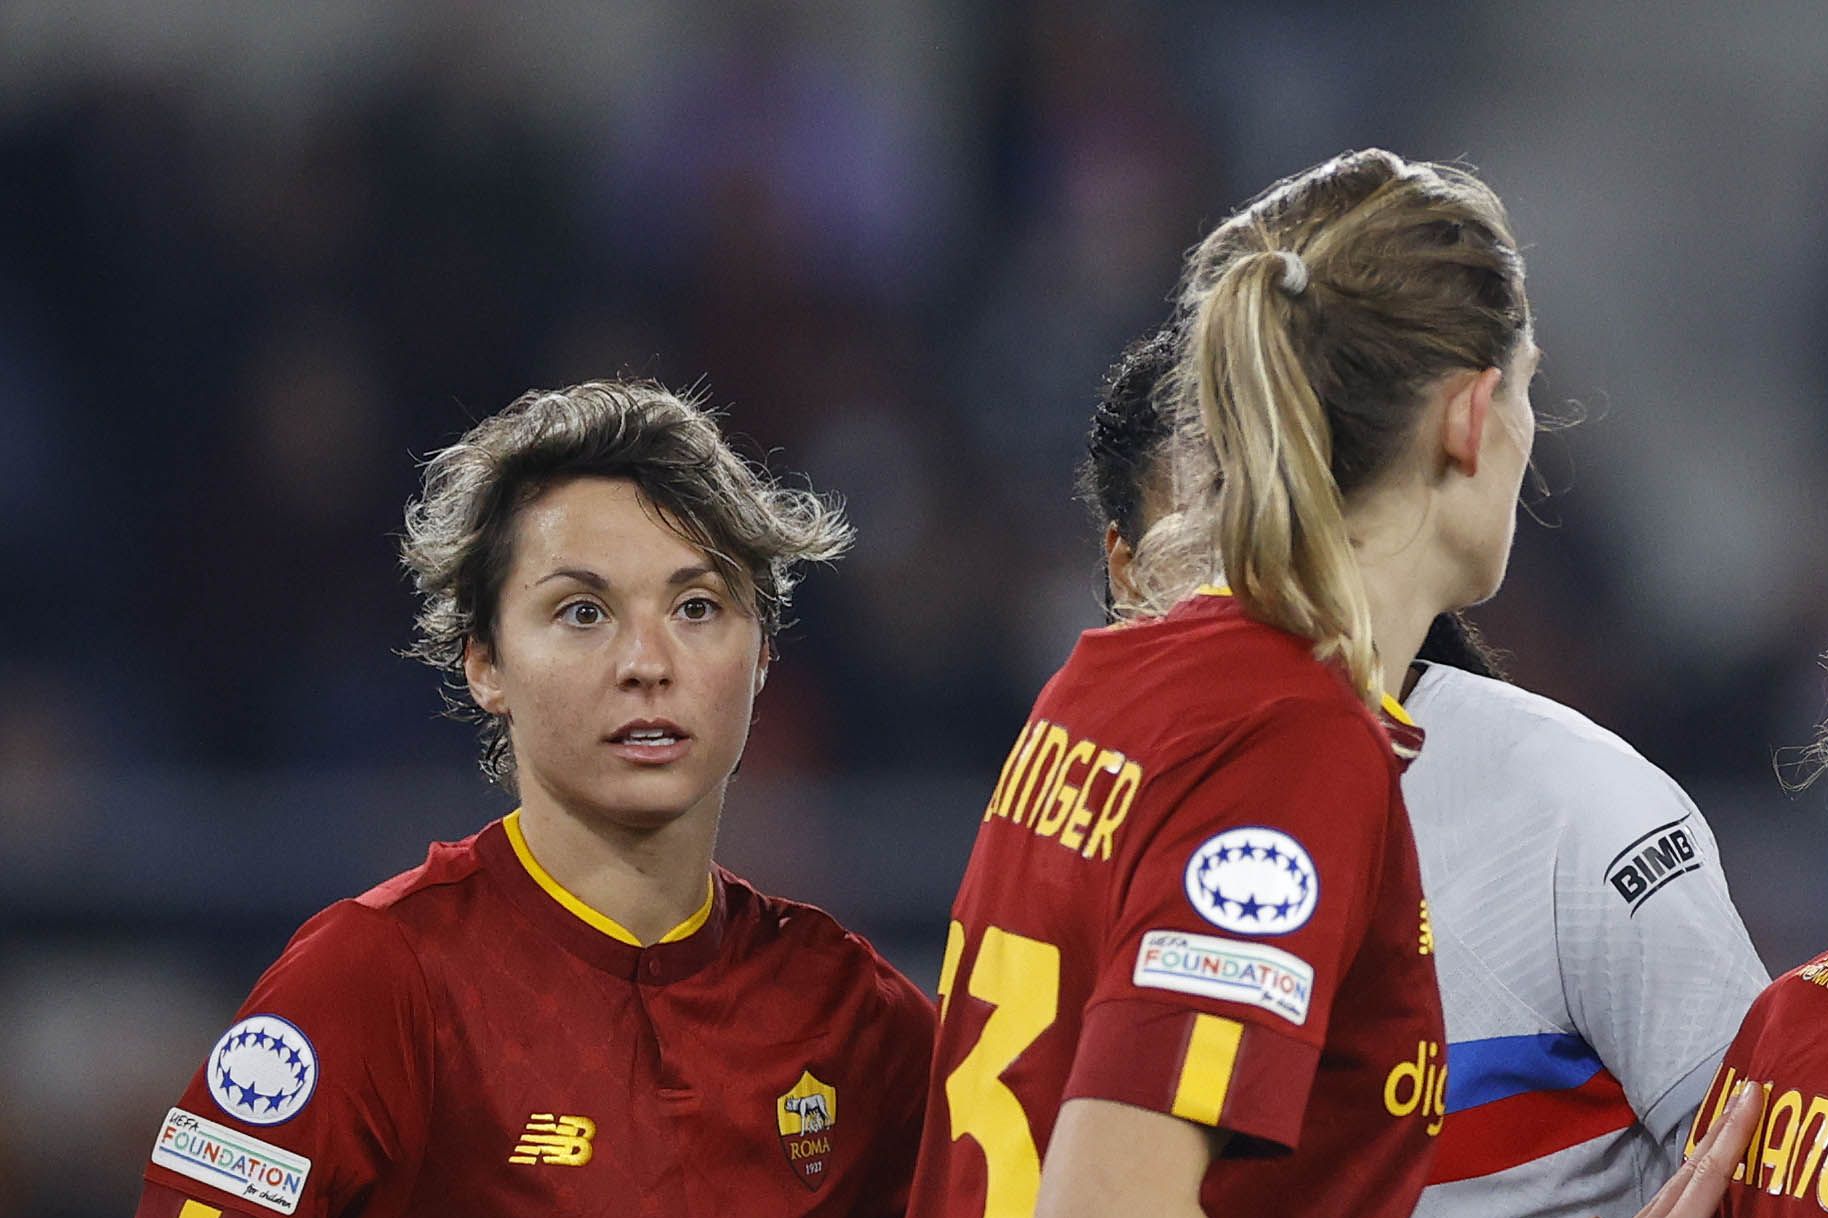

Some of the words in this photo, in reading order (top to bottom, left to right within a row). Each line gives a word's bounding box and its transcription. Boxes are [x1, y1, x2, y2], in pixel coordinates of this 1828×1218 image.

[1610, 828, 1698, 904] BIMB
[169, 1111, 199, 1132] UEFA
[790, 1137, 831, 1160] ROMA
